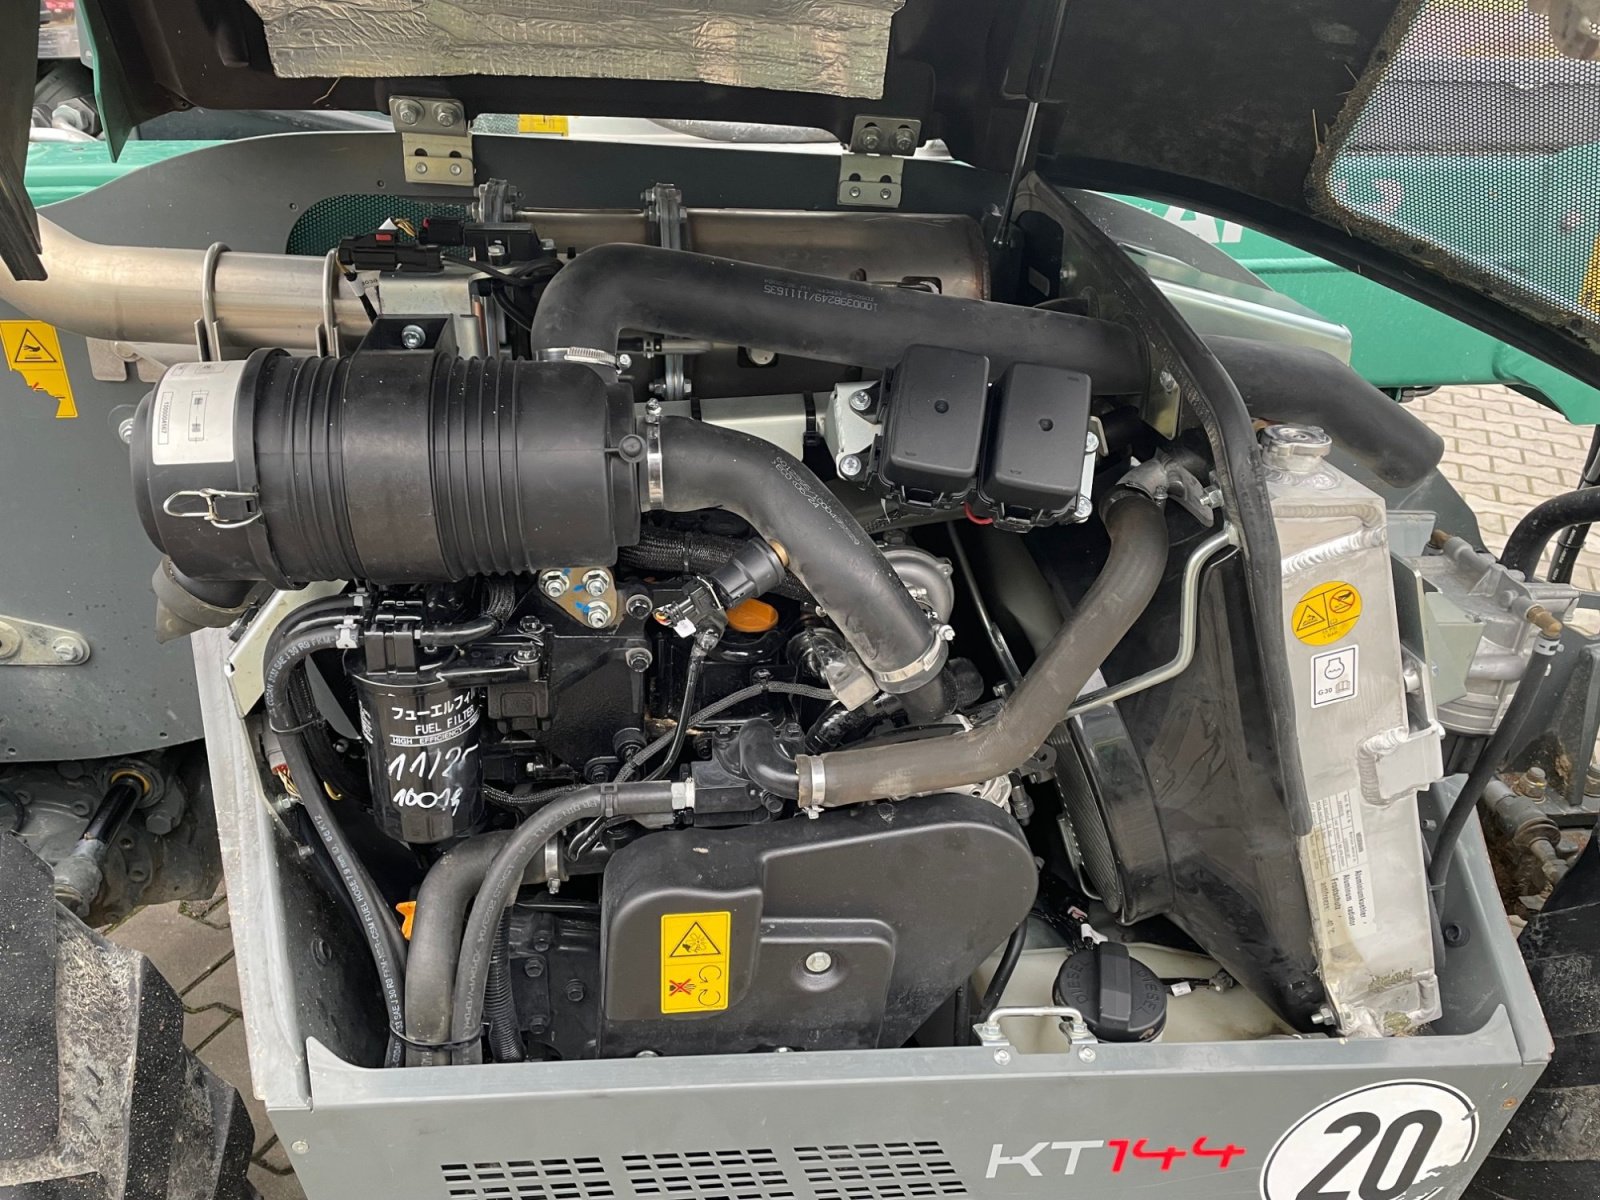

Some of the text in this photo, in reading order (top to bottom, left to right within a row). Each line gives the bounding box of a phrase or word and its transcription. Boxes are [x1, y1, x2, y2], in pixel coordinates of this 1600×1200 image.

[273, 656, 288, 670] SAE
[288, 646, 300, 656] 30
[415, 722, 442, 736] FUEL
[447, 704, 475, 728] FILTER
[392, 726, 463, 745] HIGH EFFICIENCY
[336, 854, 347, 868] mm
[348, 880, 364, 902] HOSE
[360, 902, 373, 922] FUEL
[1067, 961, 1091, 1004] DIESEL
[1136, 969, 1160, 1014] DIESEL
[388, 989, 397, 1000] 30
[392, 1004, 402, 1020] SAE
[1295, 1109, 1443, 1200] 20
